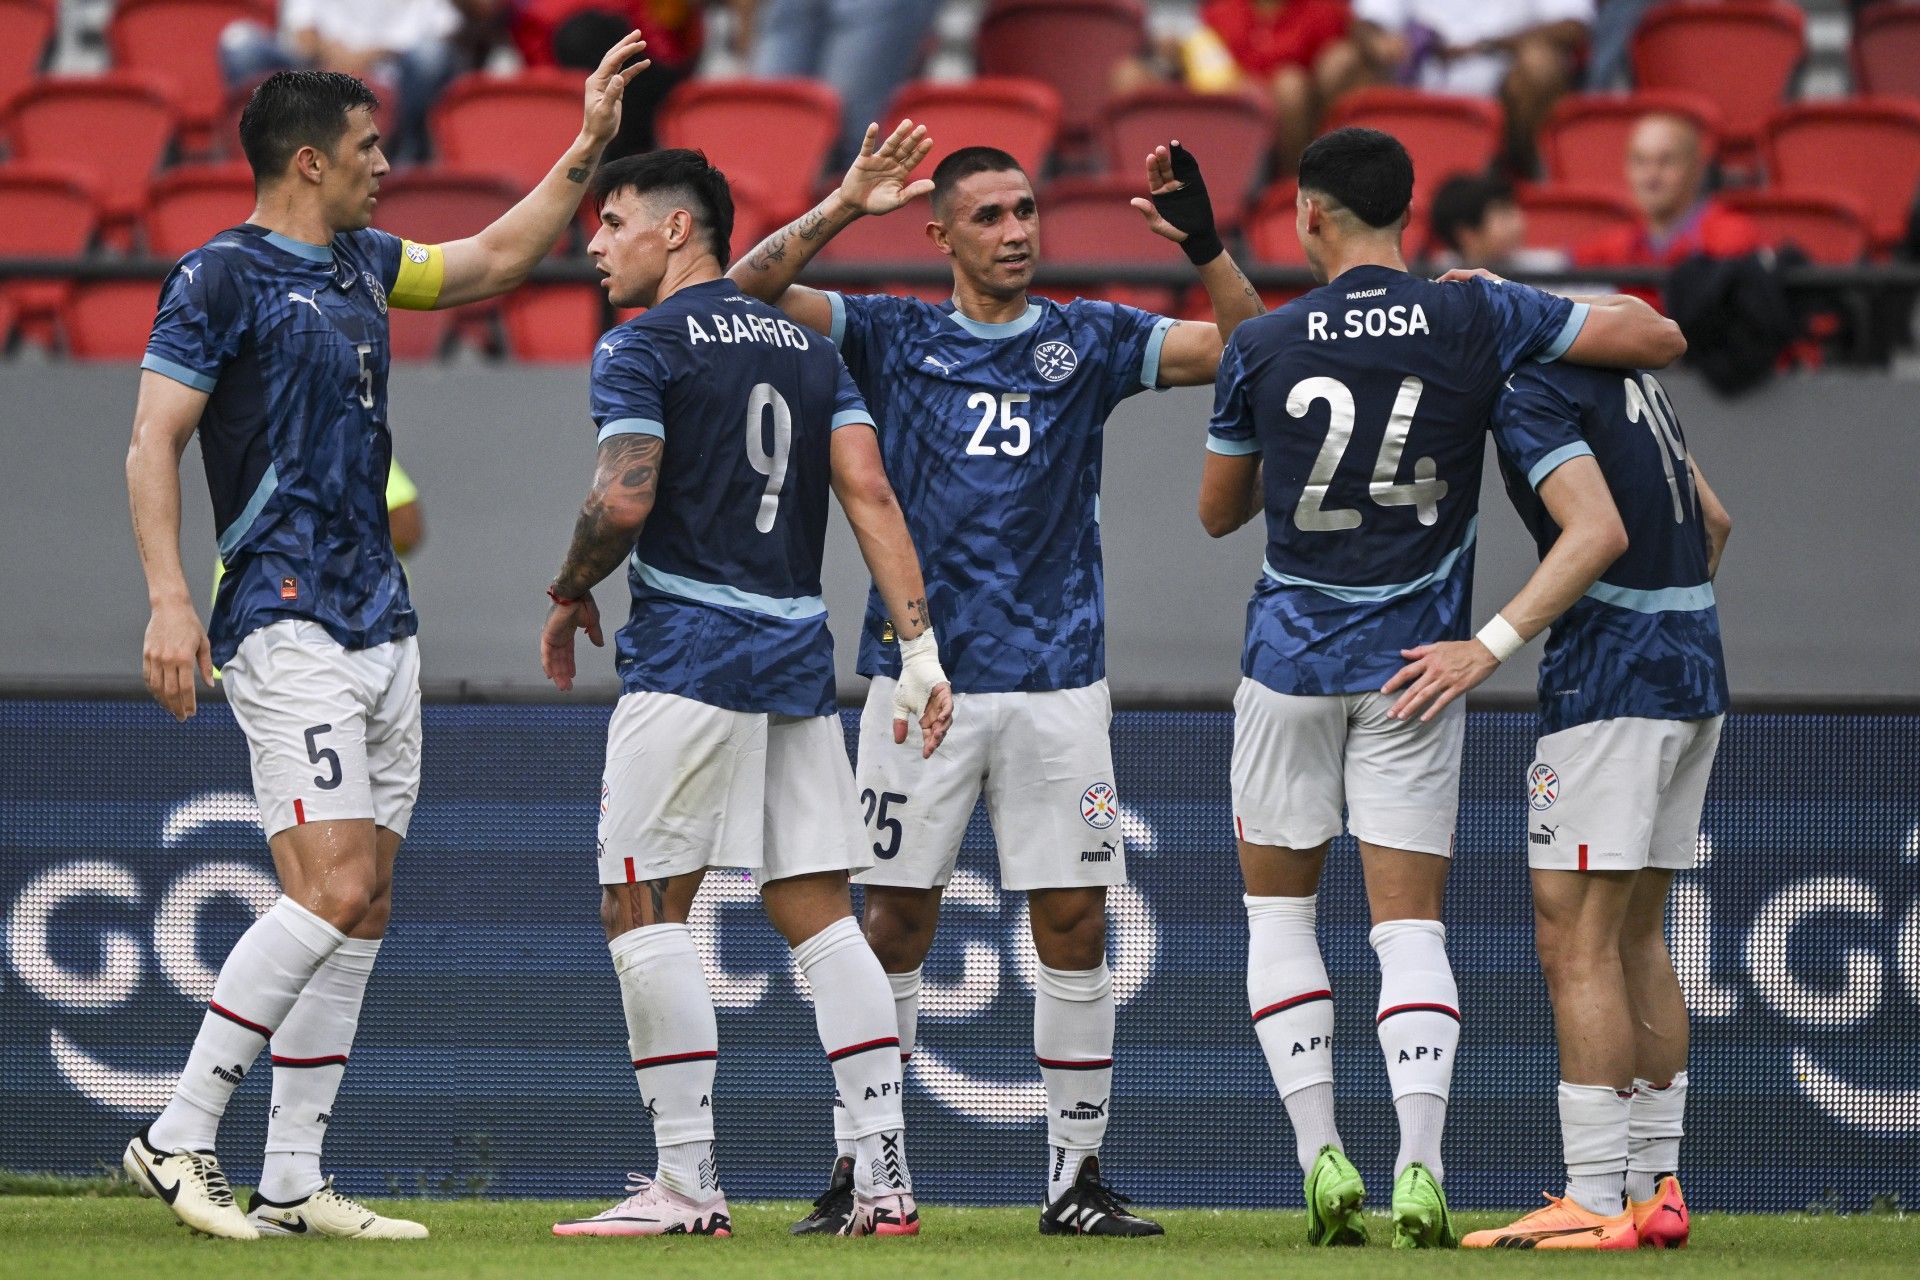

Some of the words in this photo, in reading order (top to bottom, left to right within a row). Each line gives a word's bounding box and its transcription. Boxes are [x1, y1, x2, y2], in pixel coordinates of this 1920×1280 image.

[1346, 288, 1387, 300] PARAGUAY
[1343, 303, 1430, 338] SOSA
[1042, 345, 1056, 354] APF
[357, 344, 374, 409] 5
[966, 392, 1031, 457] 25
[745, 382, 792, 533] 9
[1285, 375, 1448, 531] 24
[1623, 373, 1695, 524] 19
[304, 723, 343, 790] 5
[1094, 786, 1106, 795] APF
[1081, 851, 1111, 862] PUMA
[1398, 1046, 1443, 1064] APF
[1060, 1109, 1099, 1121] PUMA
